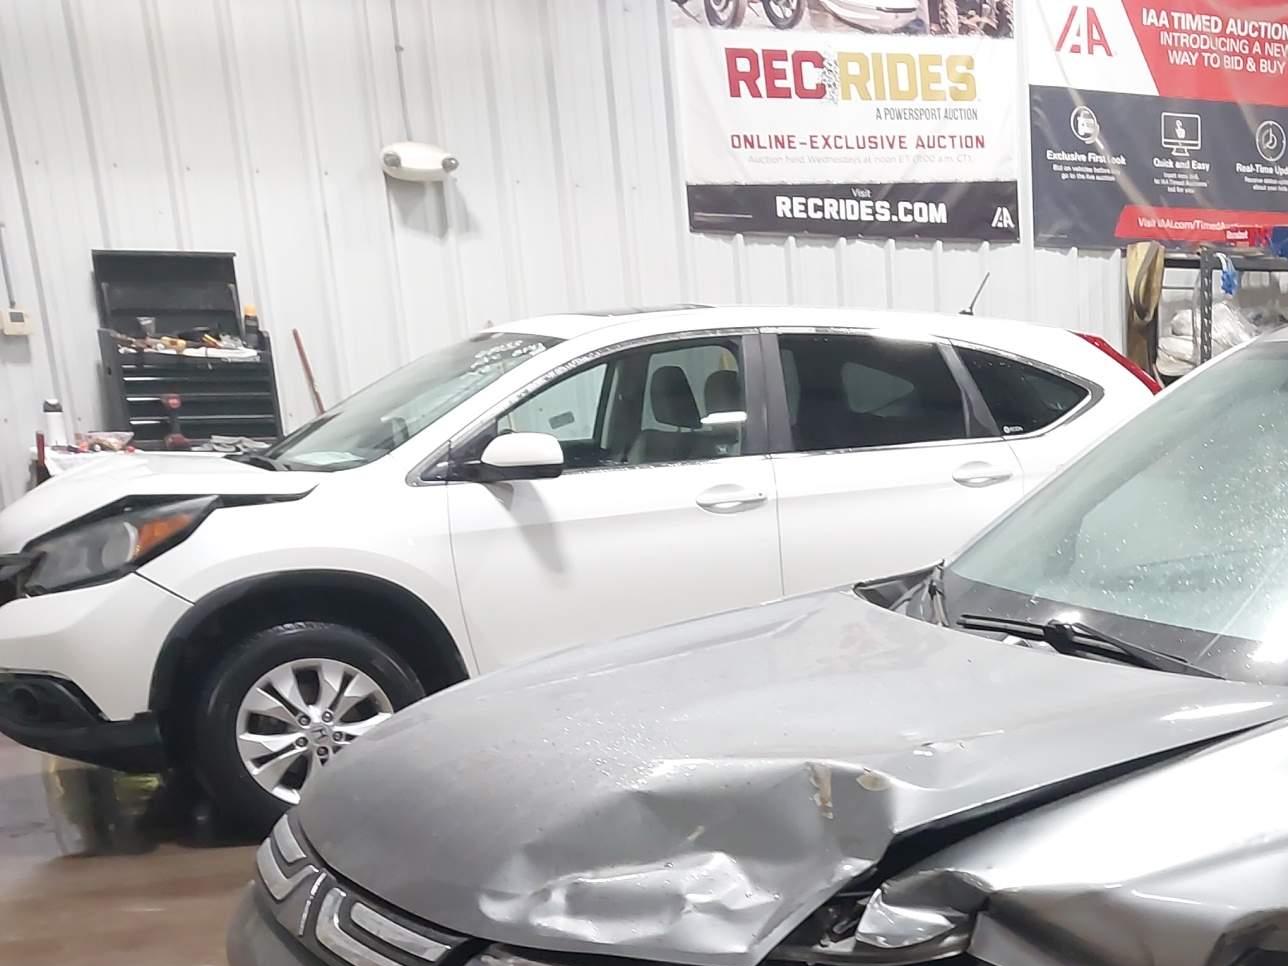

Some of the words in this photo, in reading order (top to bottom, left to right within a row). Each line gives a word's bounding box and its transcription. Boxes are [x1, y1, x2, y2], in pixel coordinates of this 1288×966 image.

[1142, 8, 1169, 29] IAA
[1171, 12, 1222, 33] TIMED
[1160, 31, 1249, 54] INTRODUCING
[1252, 41, 1261, 55] A
[1168, 50, 1198, 66] WAY
[1202, 53, 1221, 68] TO
[1223, 55, 1244, 71] BID
[1246, 57, 1256, 73] &
[1259, 58, 1286, 75] BUY
[725, 47, 828, 99] REC
[836, 51, 978, 102] RIDES
[876, 107, 883, 120] A
[884, 107, 941, 121] POWERSPORT
[943, 107, 979, 121] AUCTION
[730, 134, 908, 150] ONLINE-EXCLUSIVE
[915, 135, 987, 149] AUCTION
[1046, 150, 1087, 163] Exclusive
[1153, 157, 1174, 169] Quick
[1175, 159, 1190, 169] and
[1191, 159, 1210, 172] Easy
[1235, 162, 1273, 175] Real-Time
[851, 187, 872, 198] Visit
[775, 195, 948, 224] RECRIDES.COM
